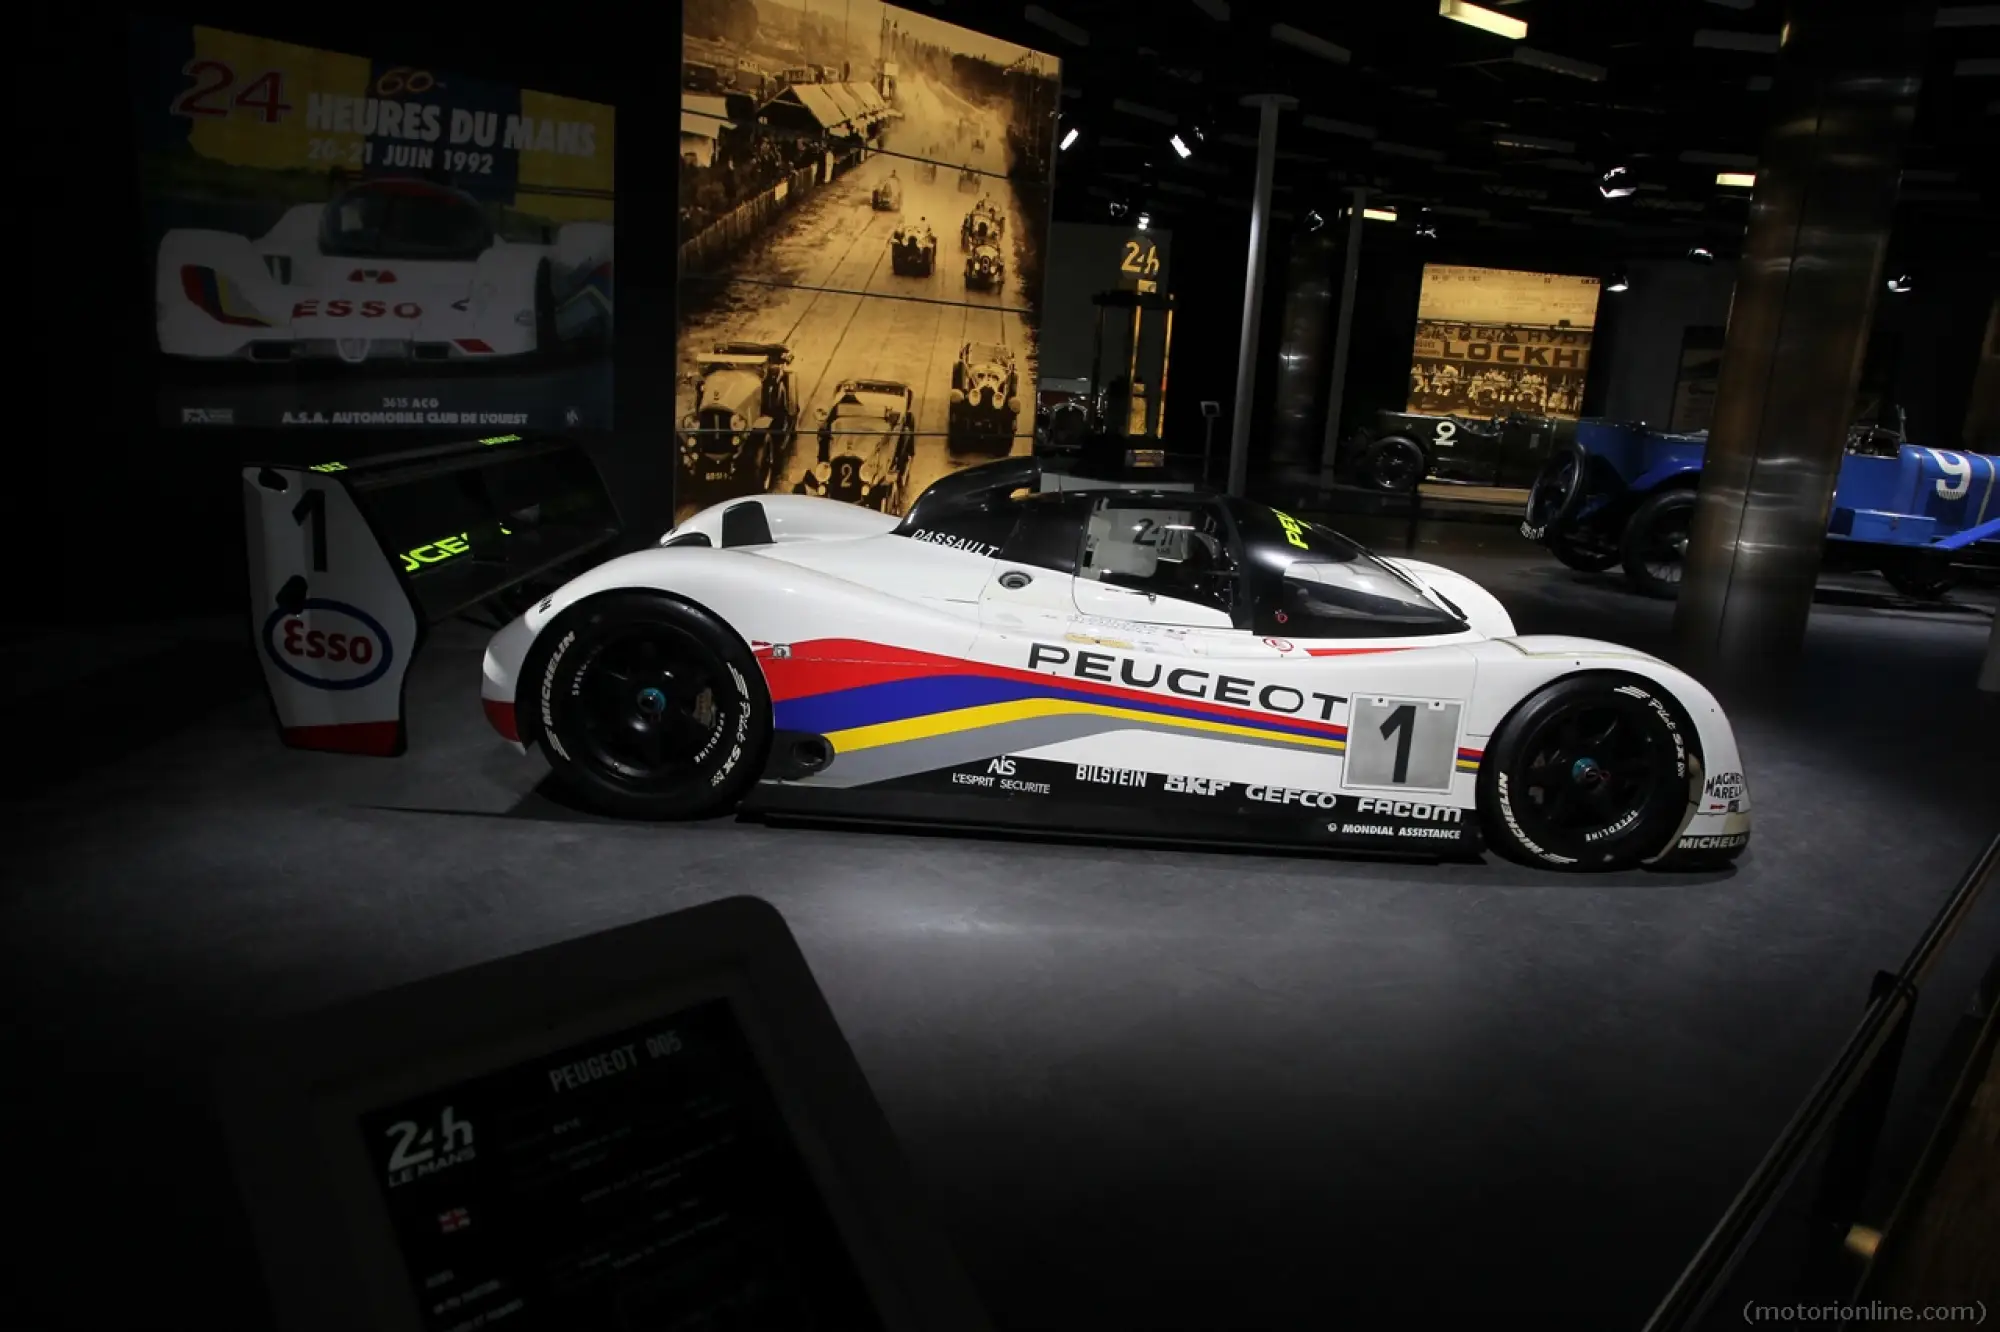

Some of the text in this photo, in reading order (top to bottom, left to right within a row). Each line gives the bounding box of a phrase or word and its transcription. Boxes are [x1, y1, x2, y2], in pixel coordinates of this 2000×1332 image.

[169, 60, 292, 123] 24
[306, 91, 596, 158] HEURES DU MANS
[307, 138, 494, 175] 20-21 JUIN 1992
[292, 300, 423, 319] ESSO
[1444, 341, 1579, 367] LOCKH
[282, 411, 529, 425] A.S.A. AUTOMOBILE CLUB DE L'OUEST
[840, 463, 853, 490] 2
[1925, 448, 1971, 500] 9
[292, 489, 327, 572] 1
[911, 528, 1000, 557] DASSAULT
[541, 630, 576, 727] MICHELIN
[1028, 642, 1347, 722] PEUGEOT
[1379, 705, 1416, 785] 1
[952, 772, 1050, 795] L'ESPRIT SECURITE
[1075, 763, 1148, 789] BILSTEIN
[1163, 773, 1231, 797] SKF
[1244, 783, 1338, 810] GEFCO
[1357, 797, 1462, 823] FACOM
[1498, 771, 1546, 856] MICHELIN
[1341, 823, 1462, 840] MONDIAL ASSISTANCE
[1585, 809, 1639, 843] SPEEDLINE
[548, 1042, 639, 1094] PEUGEOT
[384, 1104, 475, 1173] 24h
[387, 1144, 477, 1189] LE MANS
